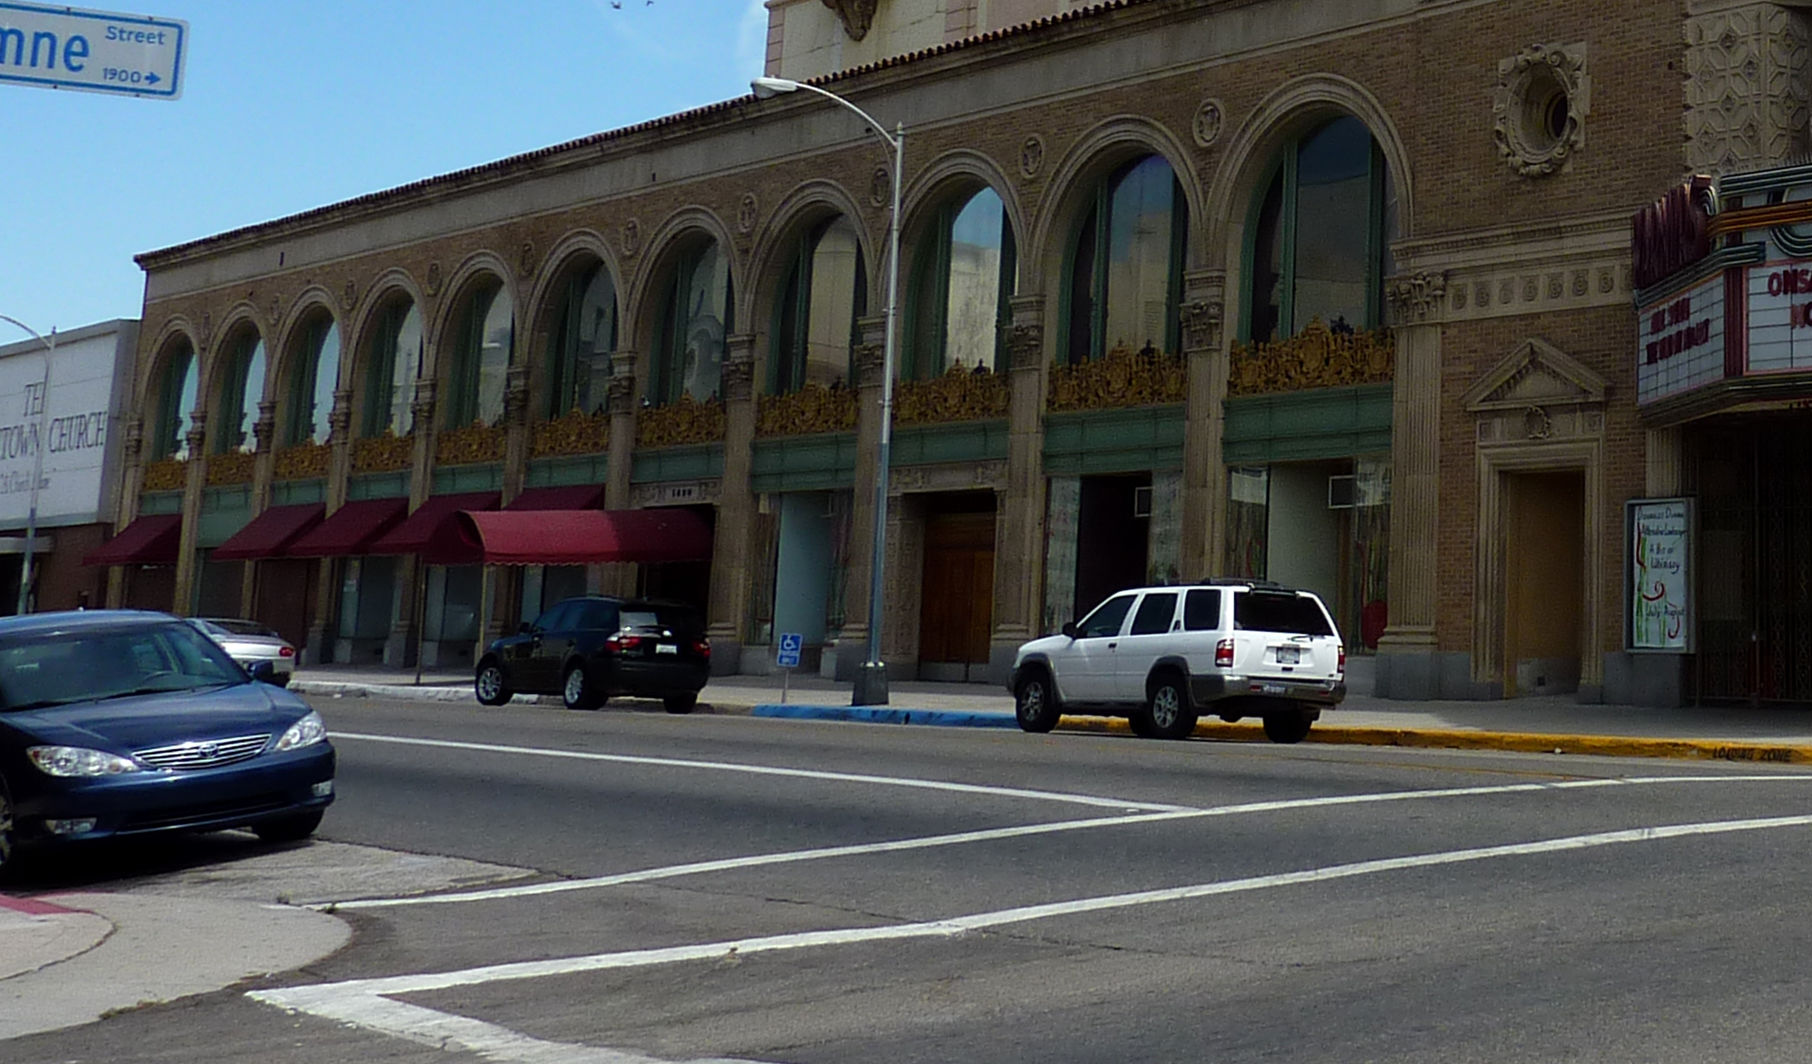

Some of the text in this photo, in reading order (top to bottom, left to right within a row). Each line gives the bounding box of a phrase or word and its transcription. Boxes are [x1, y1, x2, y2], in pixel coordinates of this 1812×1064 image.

[105, 26, 166, 45] Street
[103, 67, 142, 84] 1900
[48, 411, 107, 453] CHURCH
